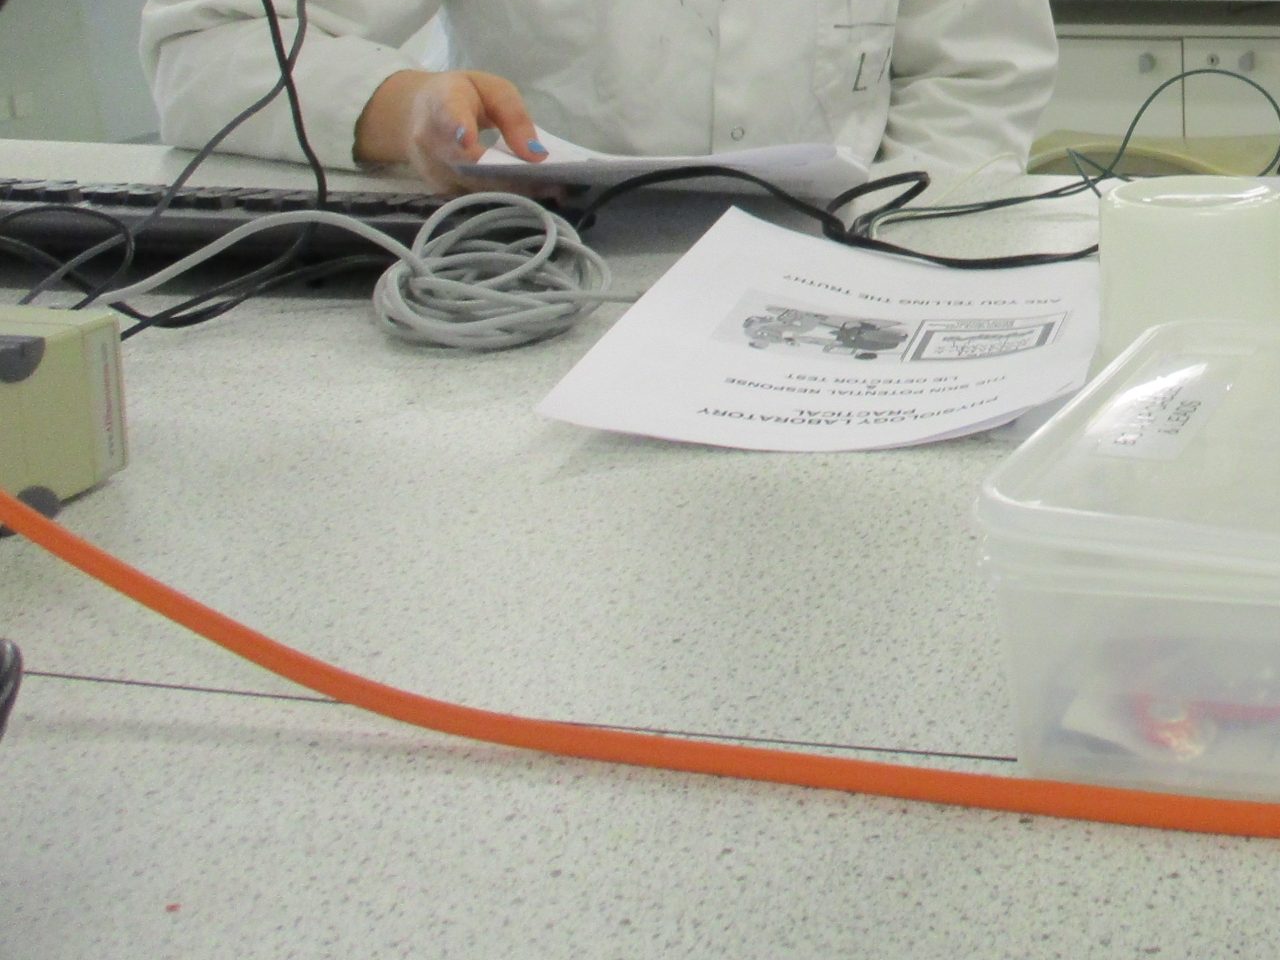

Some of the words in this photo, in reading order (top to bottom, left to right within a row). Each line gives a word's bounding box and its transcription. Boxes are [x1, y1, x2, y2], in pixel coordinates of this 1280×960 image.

[783, 274, 851, 296] TRUTH?
[858, 292, 891, 305] THE
[898, 298, 973, 306] TELLING
[979, 298, 1017, 306] YOU
[1024, 297, 1061, 305] ARE
[785, 373, 827, 383] TEST
[836, 377, 928, 386] DETECTOR
[934, 375, 960, 383] LIE
[976, 375, 1007, 385] THE
[724, 377, 823, 395] RESPONSE
[828, 386, 926, 396] POTENTIAL
[930, 382, 970, 393] SKIN
[793, 407, 917, 419] PRACTICAL
[857, 395, 999, 425] PHYSIOLOGY
[697, 407, 852, 426] LABORATORY
